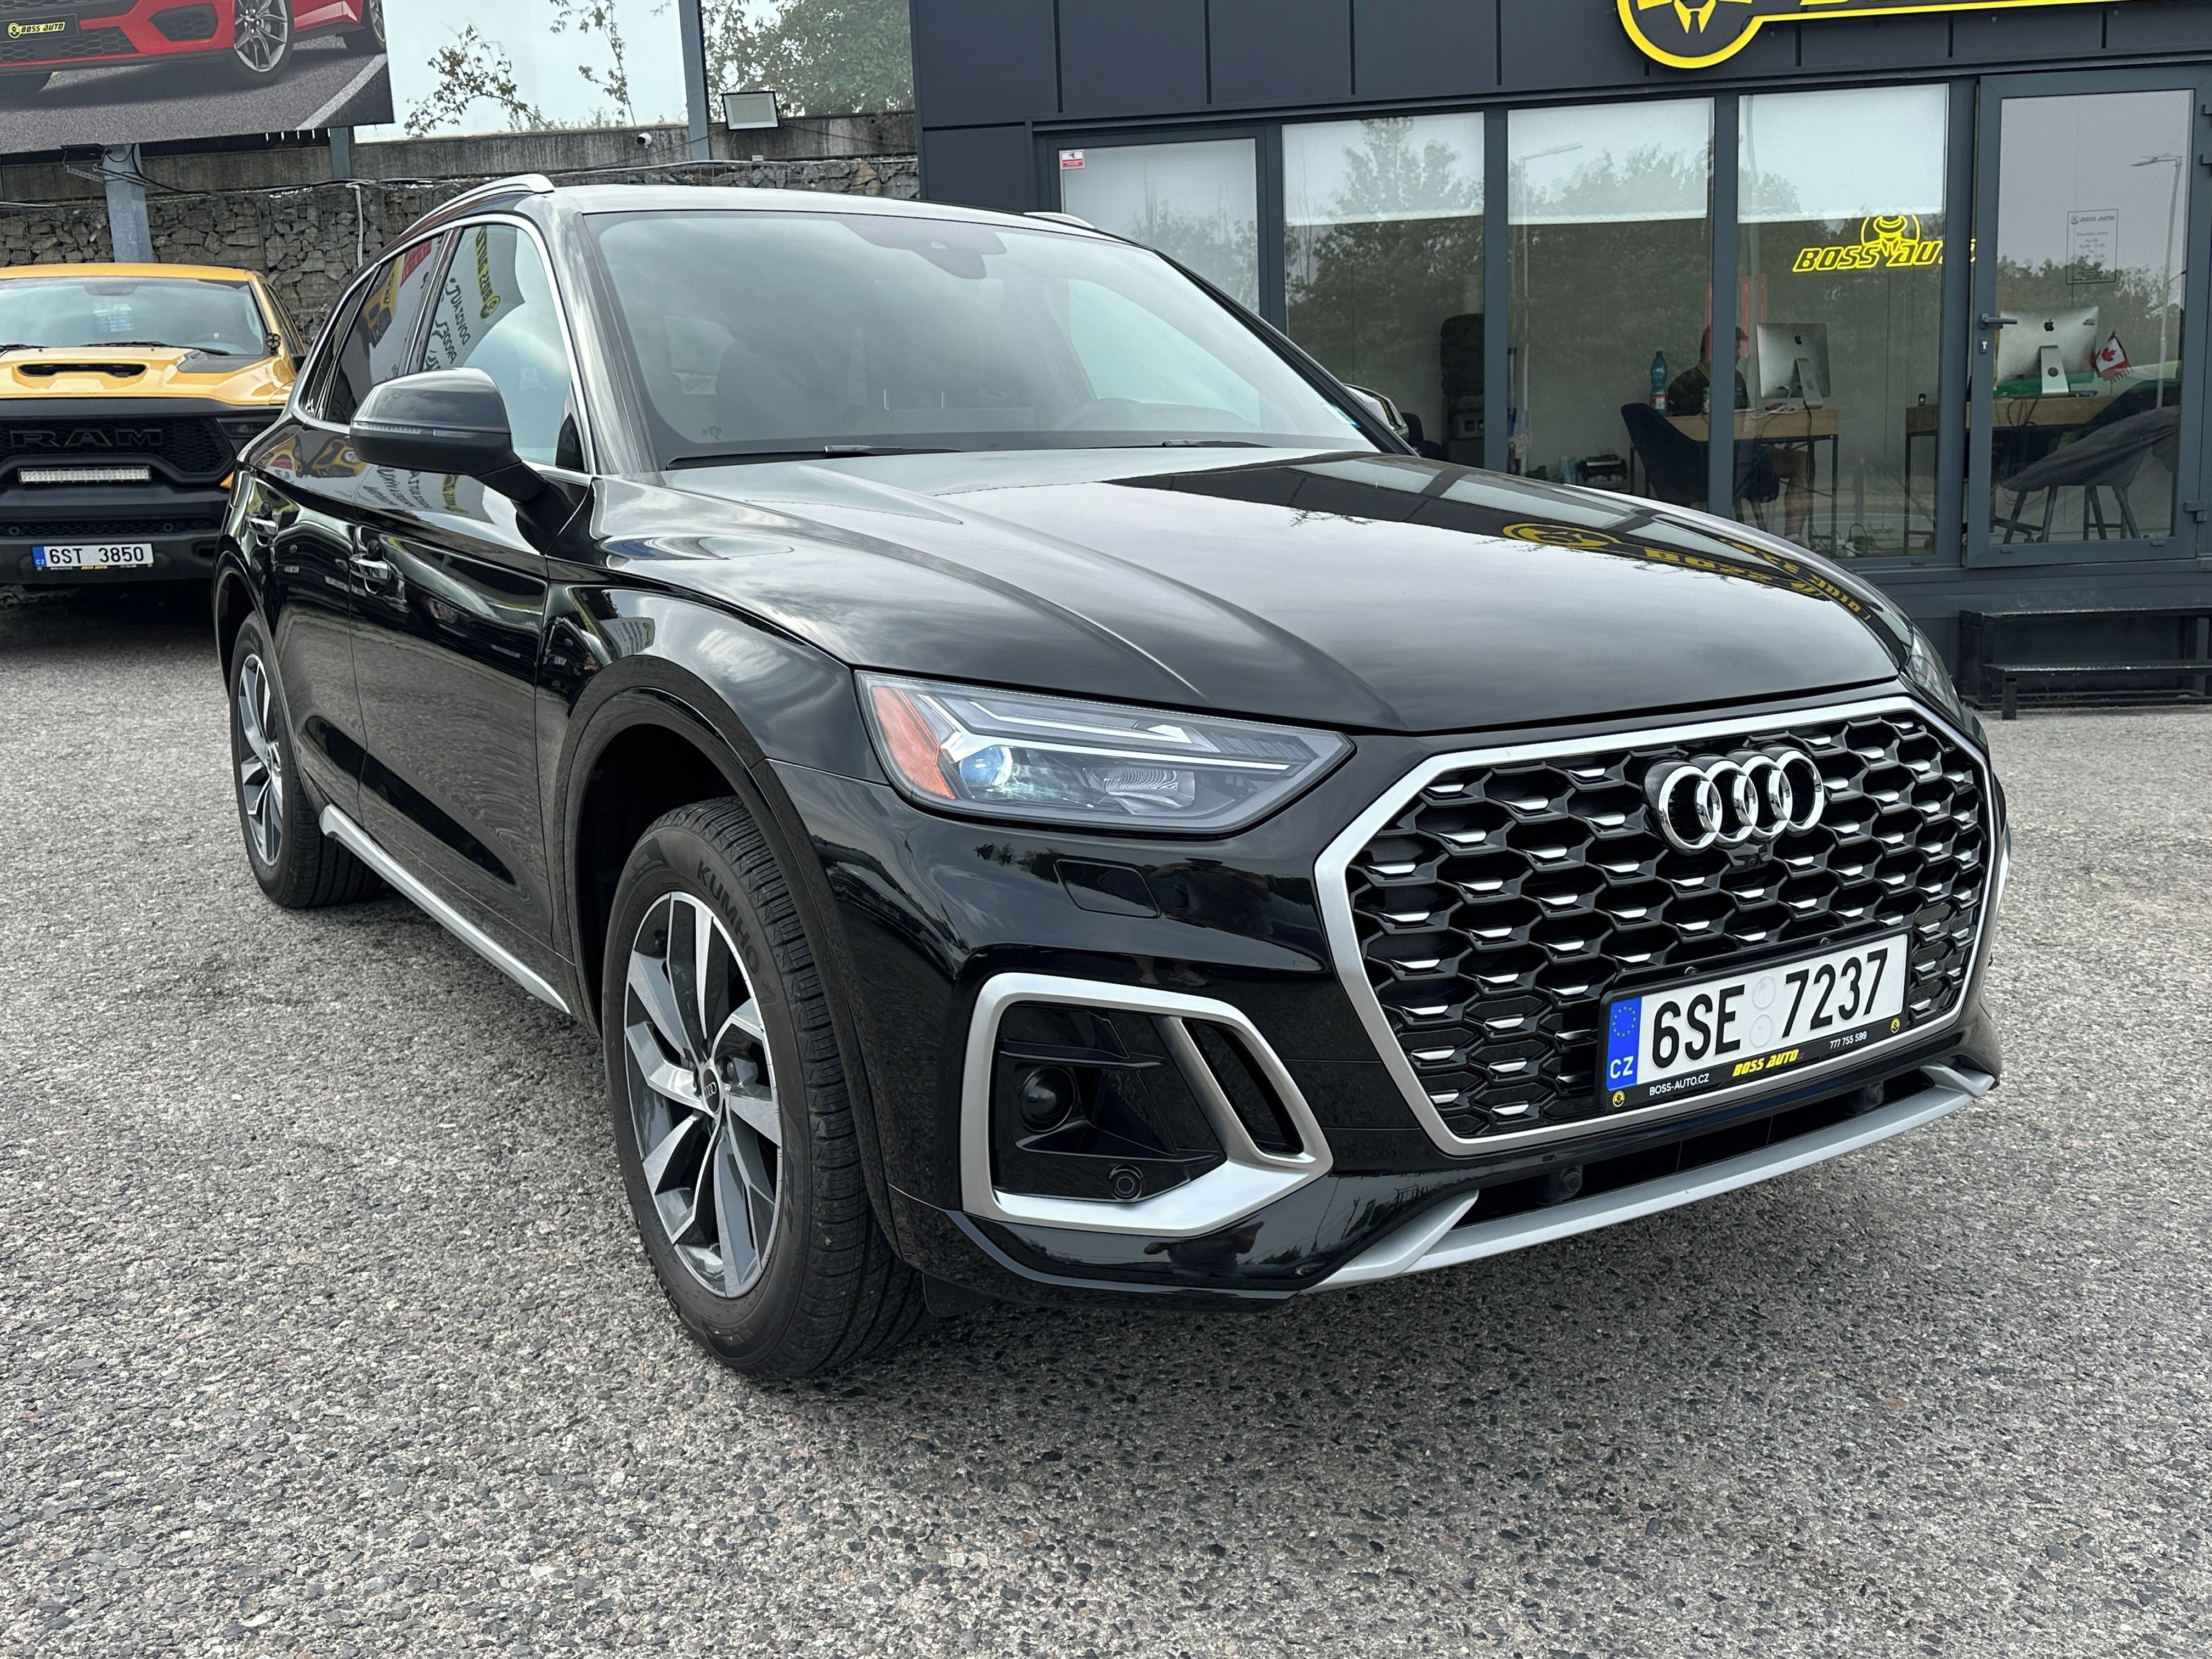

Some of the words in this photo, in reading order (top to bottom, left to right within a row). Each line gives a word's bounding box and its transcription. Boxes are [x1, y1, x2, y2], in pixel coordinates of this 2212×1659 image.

[43, 23, 64, 31] AUTO
[1792, 244, 1881, 272] BOSS
[9, 428, 163, 448] RAM
[49, 548, 83, 564] 6ST
[98, 546, 144, 563] 3850
[697, 860, 759, 975] KUMHO
[1610, 1055, 1633, 1080] CZ
[1652, 984, 1745, 1069] 6SE
[1781, 947, 1888, 1039] 7237
[1649, 1073, 1710, 1096] BOSS-AUTO.CZ
[1732, 1058, 1764, 1077] BOSS
[1765, 1048, 1799, 1069] AUTO
[1830, 1039, 1841, 1049] 777
[1842, 1035, 1854, 1046] 755
[1855, 1031, 1867, 1042] 599
